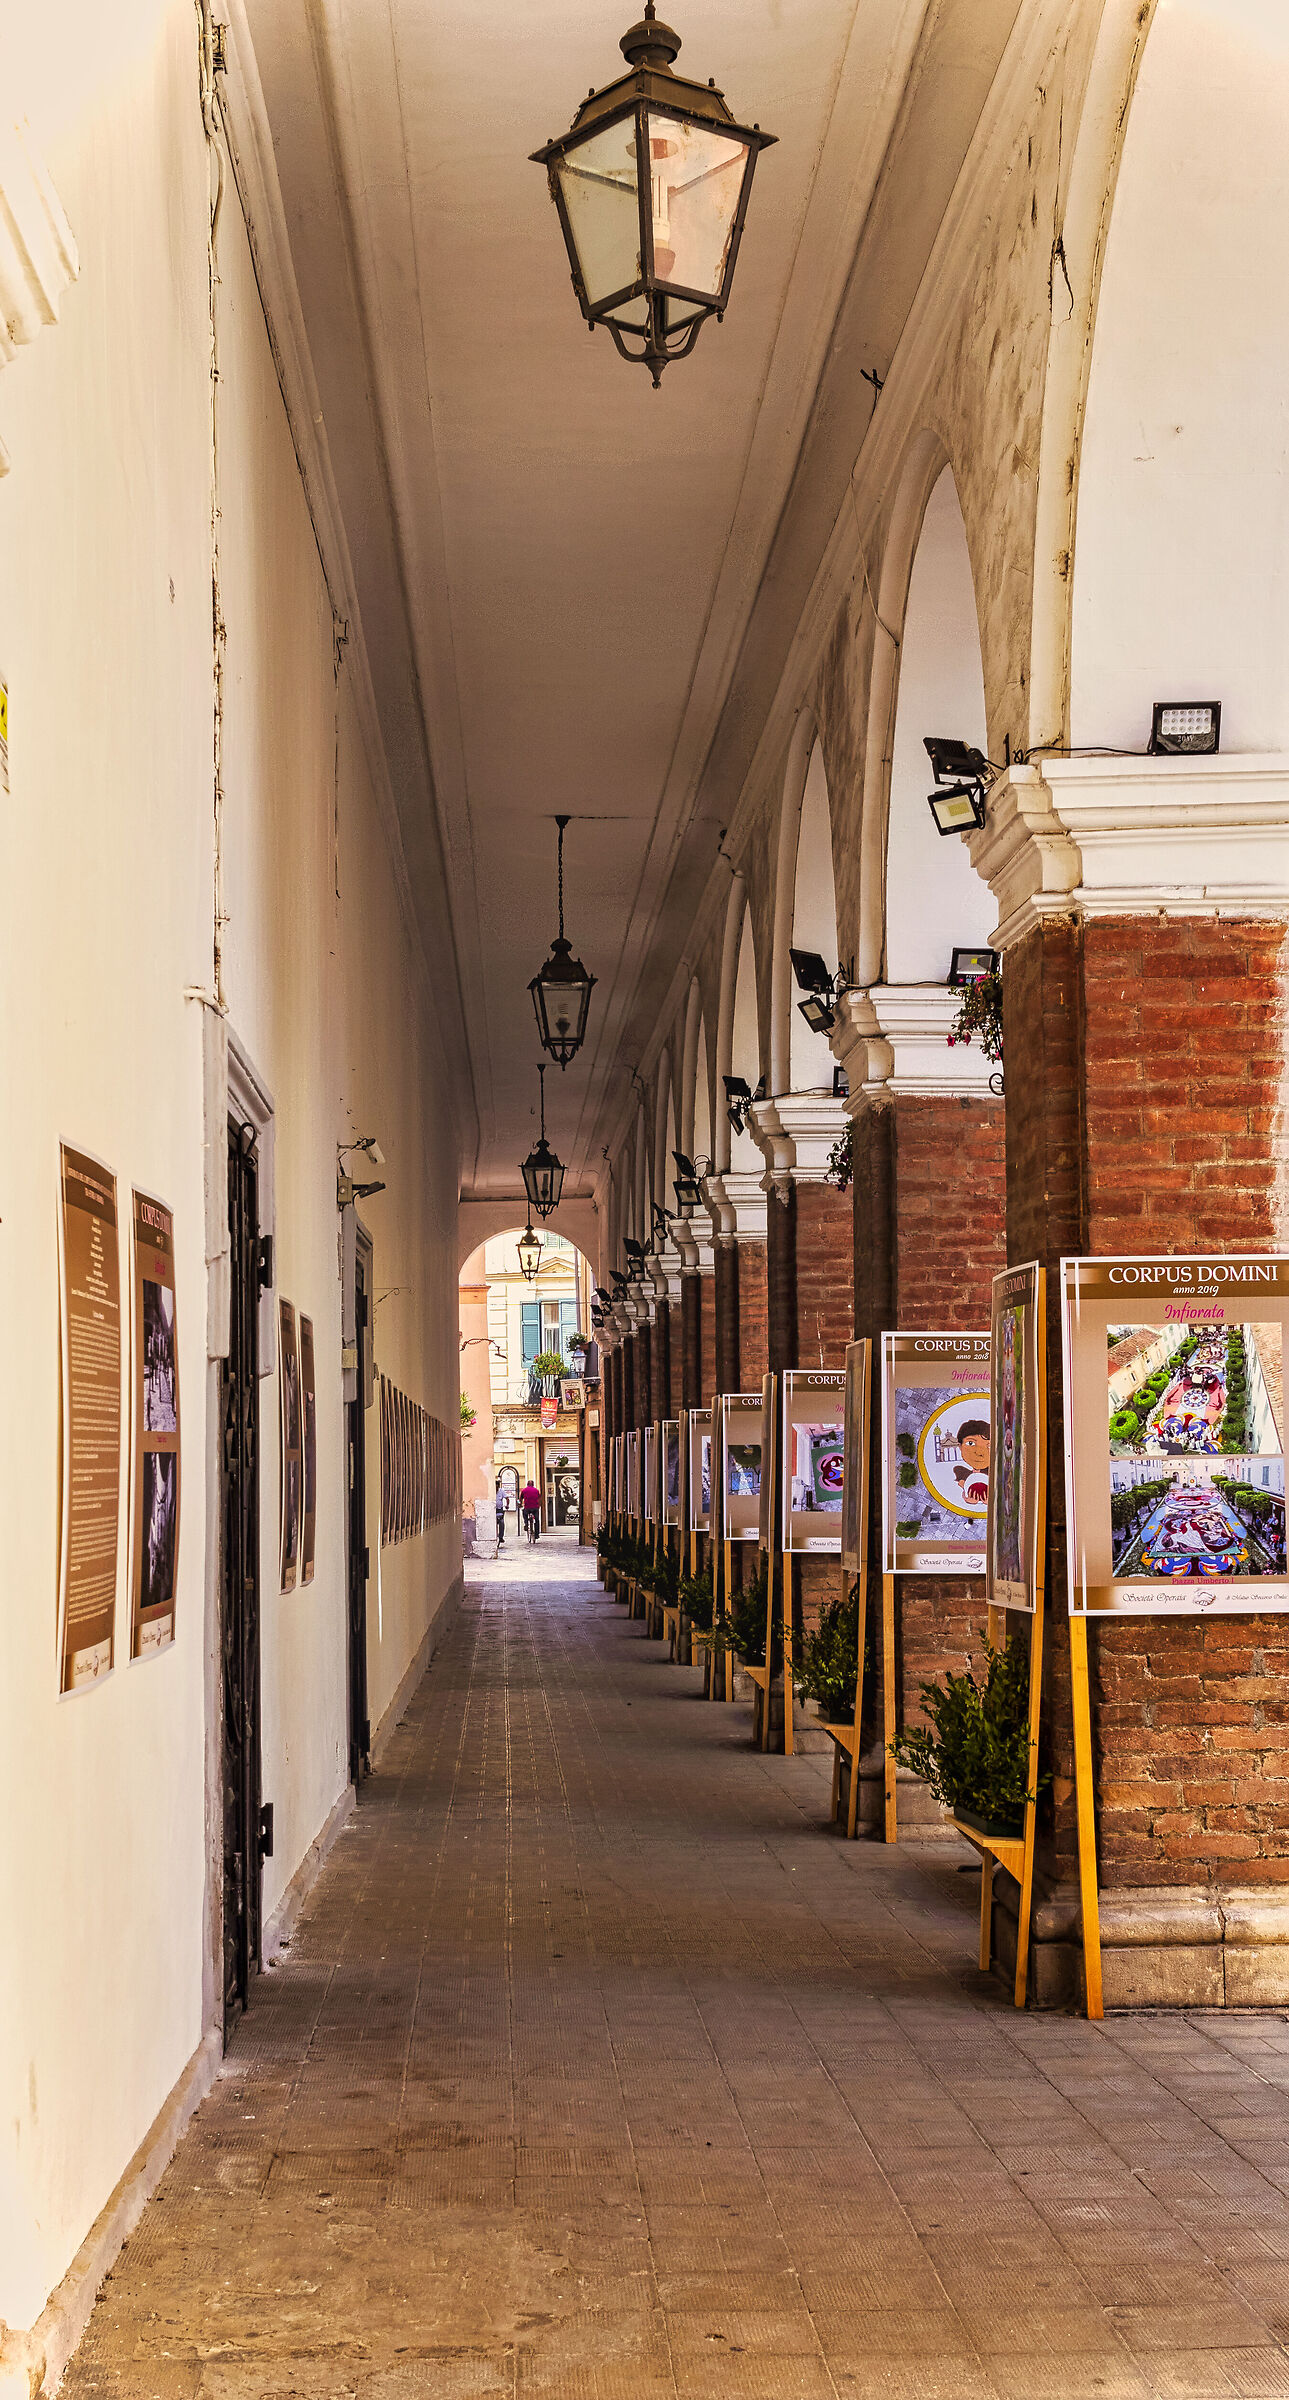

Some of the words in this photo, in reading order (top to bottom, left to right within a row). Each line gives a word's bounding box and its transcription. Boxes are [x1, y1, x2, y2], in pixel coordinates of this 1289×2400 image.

[1108, 1266, 1192, 1284] CORPUS
[1197, 1265, 1278, 1282] DOMINI
[1172, 1286, 1195, 1294] anno
[1197, 1285, 1219, 1296] 2019
[1164, 1301, 1225, 1323] Infiorata
[914, 1340, 971, 1352] CORPUS
[973, 1352, 990, 1360] 2018
